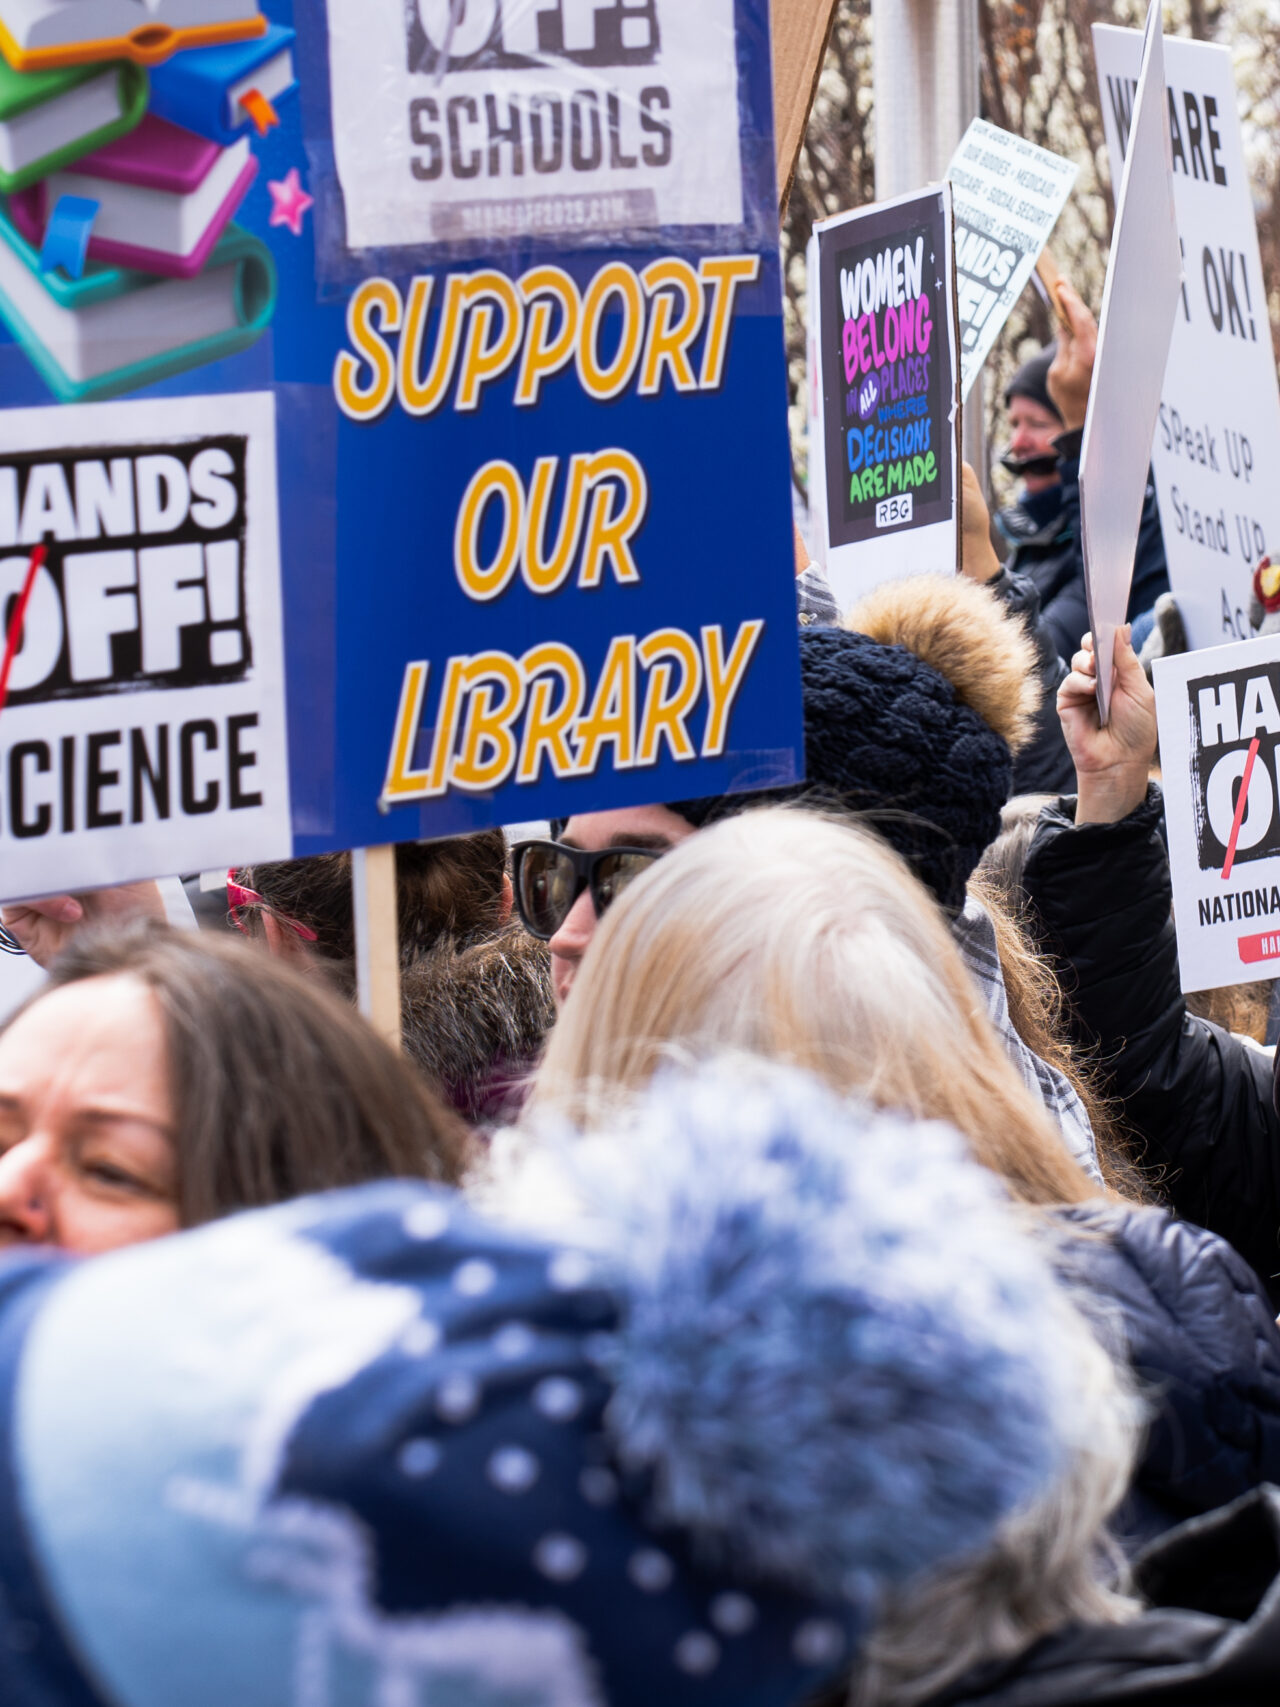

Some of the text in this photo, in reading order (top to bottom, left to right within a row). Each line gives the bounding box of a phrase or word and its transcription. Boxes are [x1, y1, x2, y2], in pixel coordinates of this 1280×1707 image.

[408, 85, 673, 180] SCHOOLS
[1166, 86, 1227, 187] ARE
[1015, 168, 1056, 199] MEDICAID
[840, 236, 924, 321] WOMEN
[1202, 245, 1256, 342] OK!
[333, 255, 761, 420] SUPPORT
[842, 293, 933, 385] BELONG
[860, 380, 878, 415] ALL
[881, 353, 931, 402] PLACES
[877, 395, 928, 424] WHERE
[847, 417, 932, 472] DECISIONS
[850, 464, 886, 504] ARE
[454, 448, 648, 601] OUR
[879, 500, 909, 523] RBG
[1170, 485, 1229, 556] Stand
[379, 619, 764, 805] LIBRARY
[8, 712, 263, 840] CIENCE
